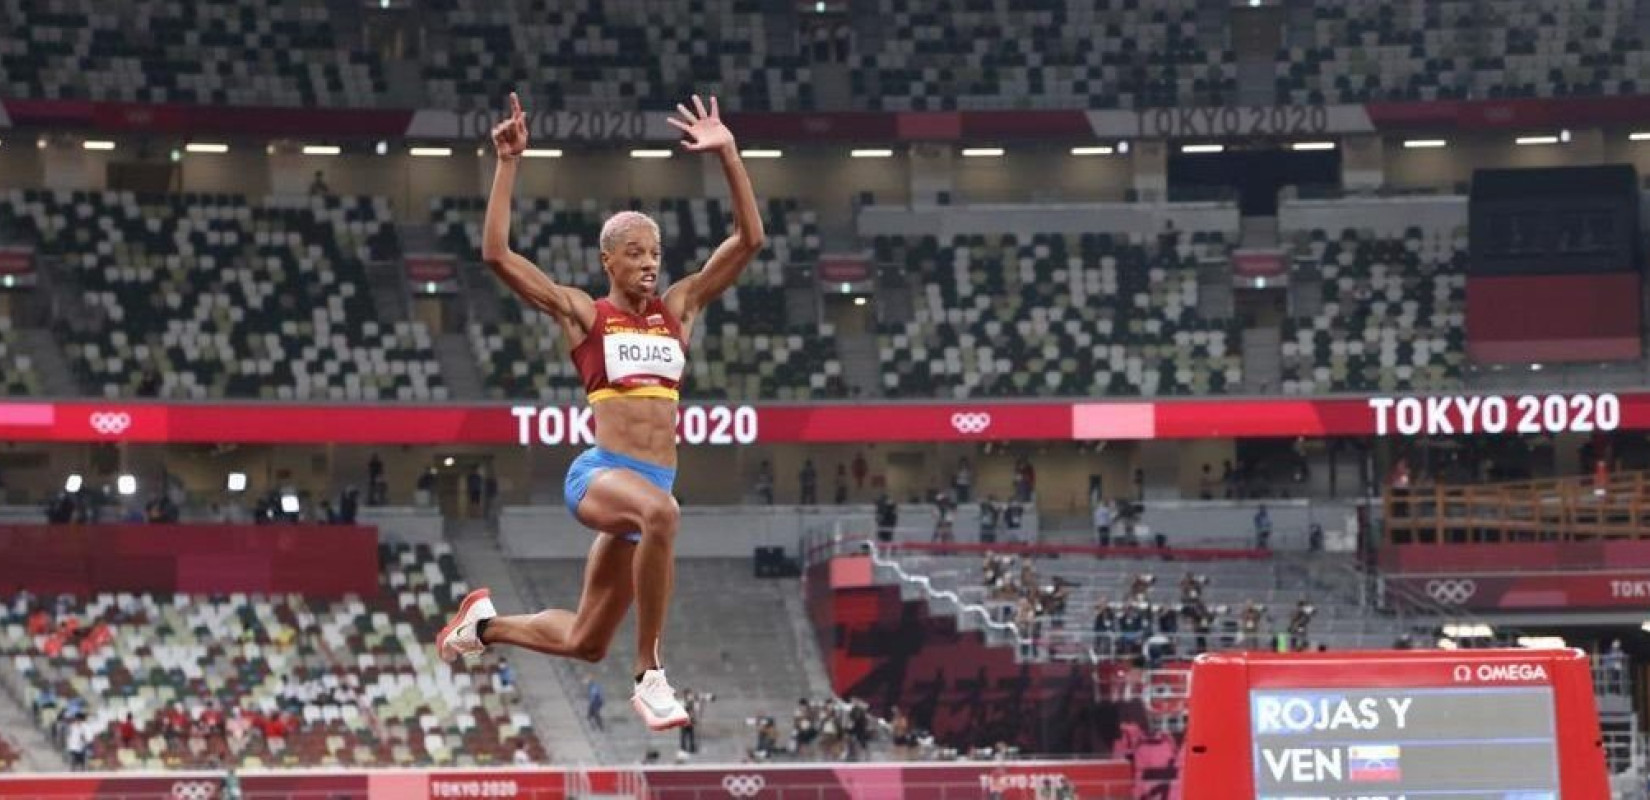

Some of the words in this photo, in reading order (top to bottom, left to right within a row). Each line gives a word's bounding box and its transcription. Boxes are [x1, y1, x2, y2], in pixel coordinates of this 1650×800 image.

[567, 109, 647, 140] 2020
[1250, 104, 1327, 136] 2020
[618, 344, 673, 362] ROJAS
[511, 406, 597, 445] TOK
[675, 405, 758, 444] 020
[1369, 395, 1508, 435] TOKYO
[1516, 393, 1620, 433] 2020
[1477, 664, 1548, 680] OMEGA
[1257, 697, 1380, 731] ROJAS
[1387, 697, 1412, 729] Y
[1262, 748, 1342, 782] VEN
